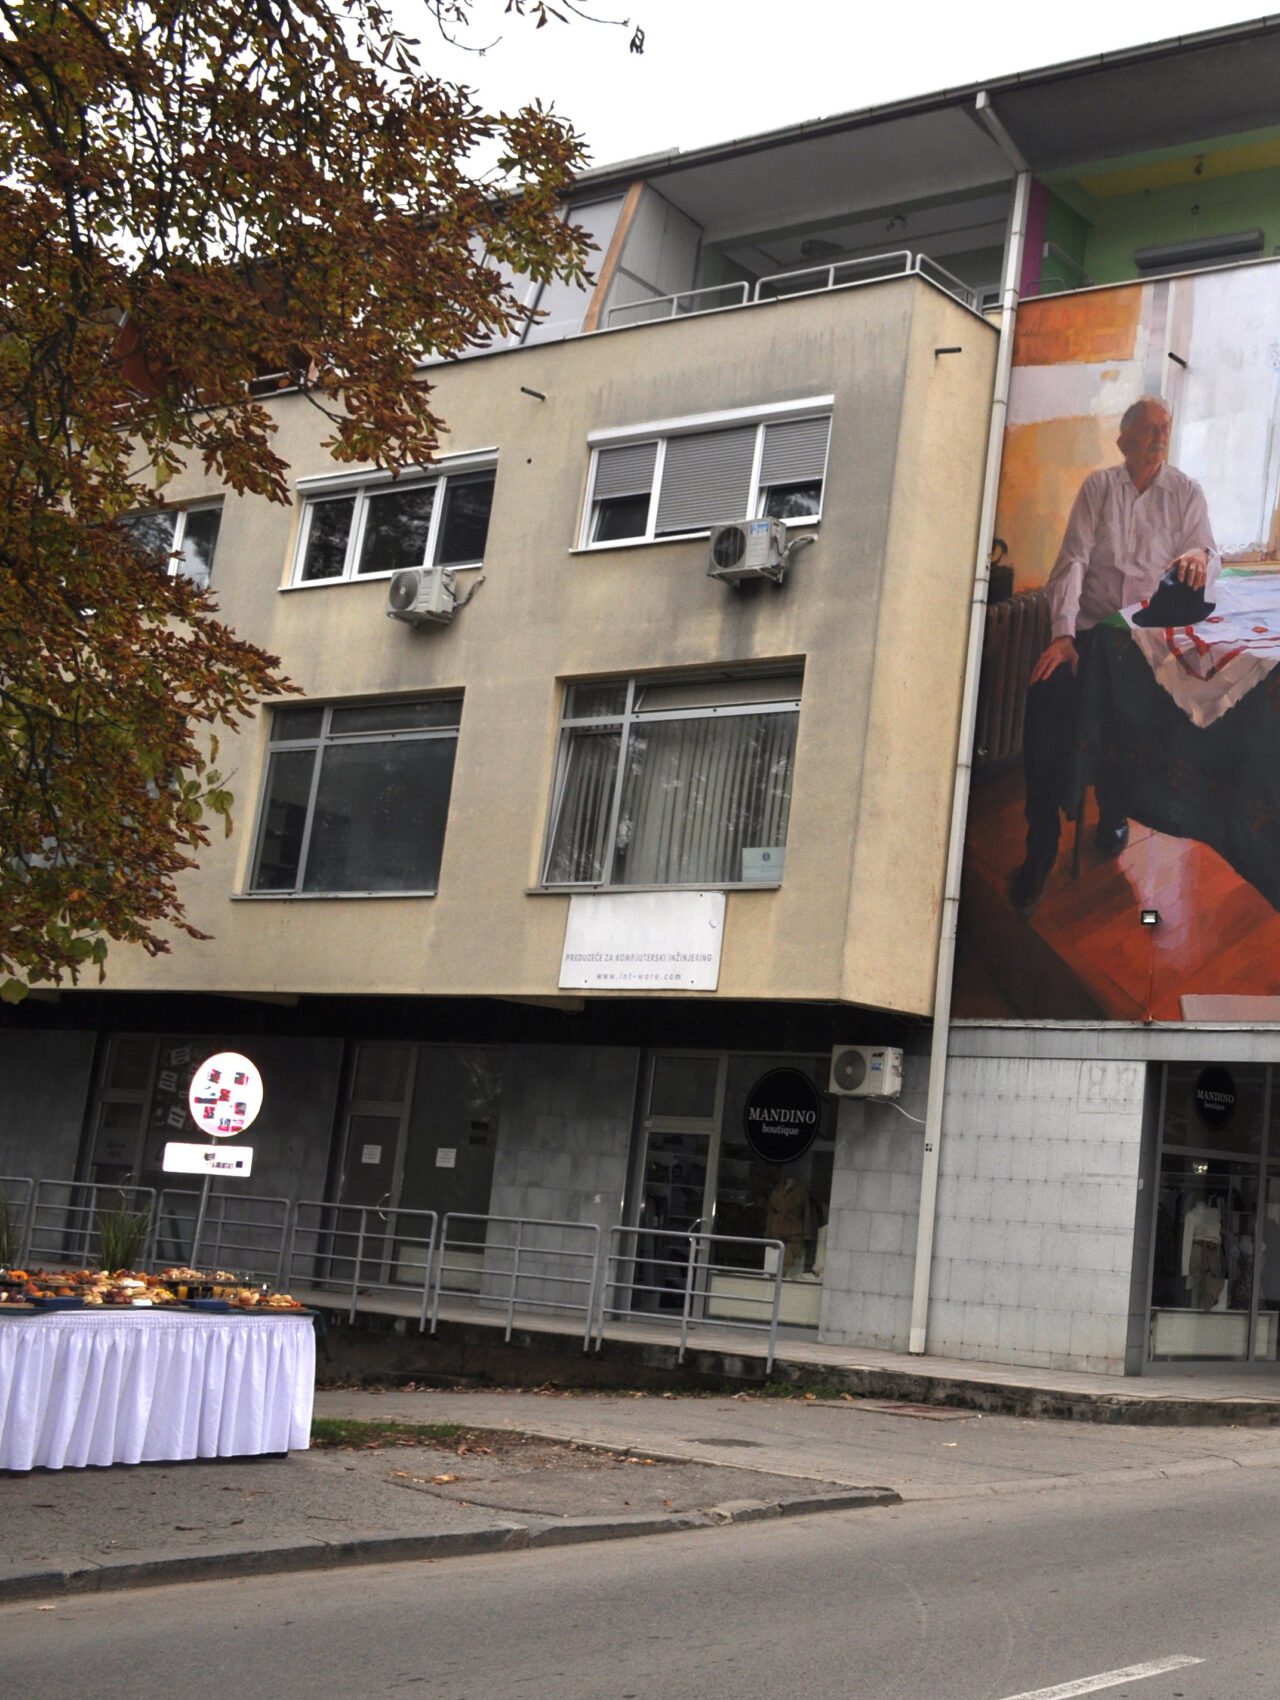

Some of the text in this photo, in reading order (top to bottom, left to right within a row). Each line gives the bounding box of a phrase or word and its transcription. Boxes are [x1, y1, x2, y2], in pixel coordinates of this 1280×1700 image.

[604, 953, 614, 962] ZA
[615, 953, 666, 962] KOMPJUTERSKI
[667, 952, 712, 962] INŽINJERING
[1196, 1088, 1235, 1104] MANDINO
[748, 1106, 817, 1124] MANDINO
[761, 1122, 800, 1137] boutique
